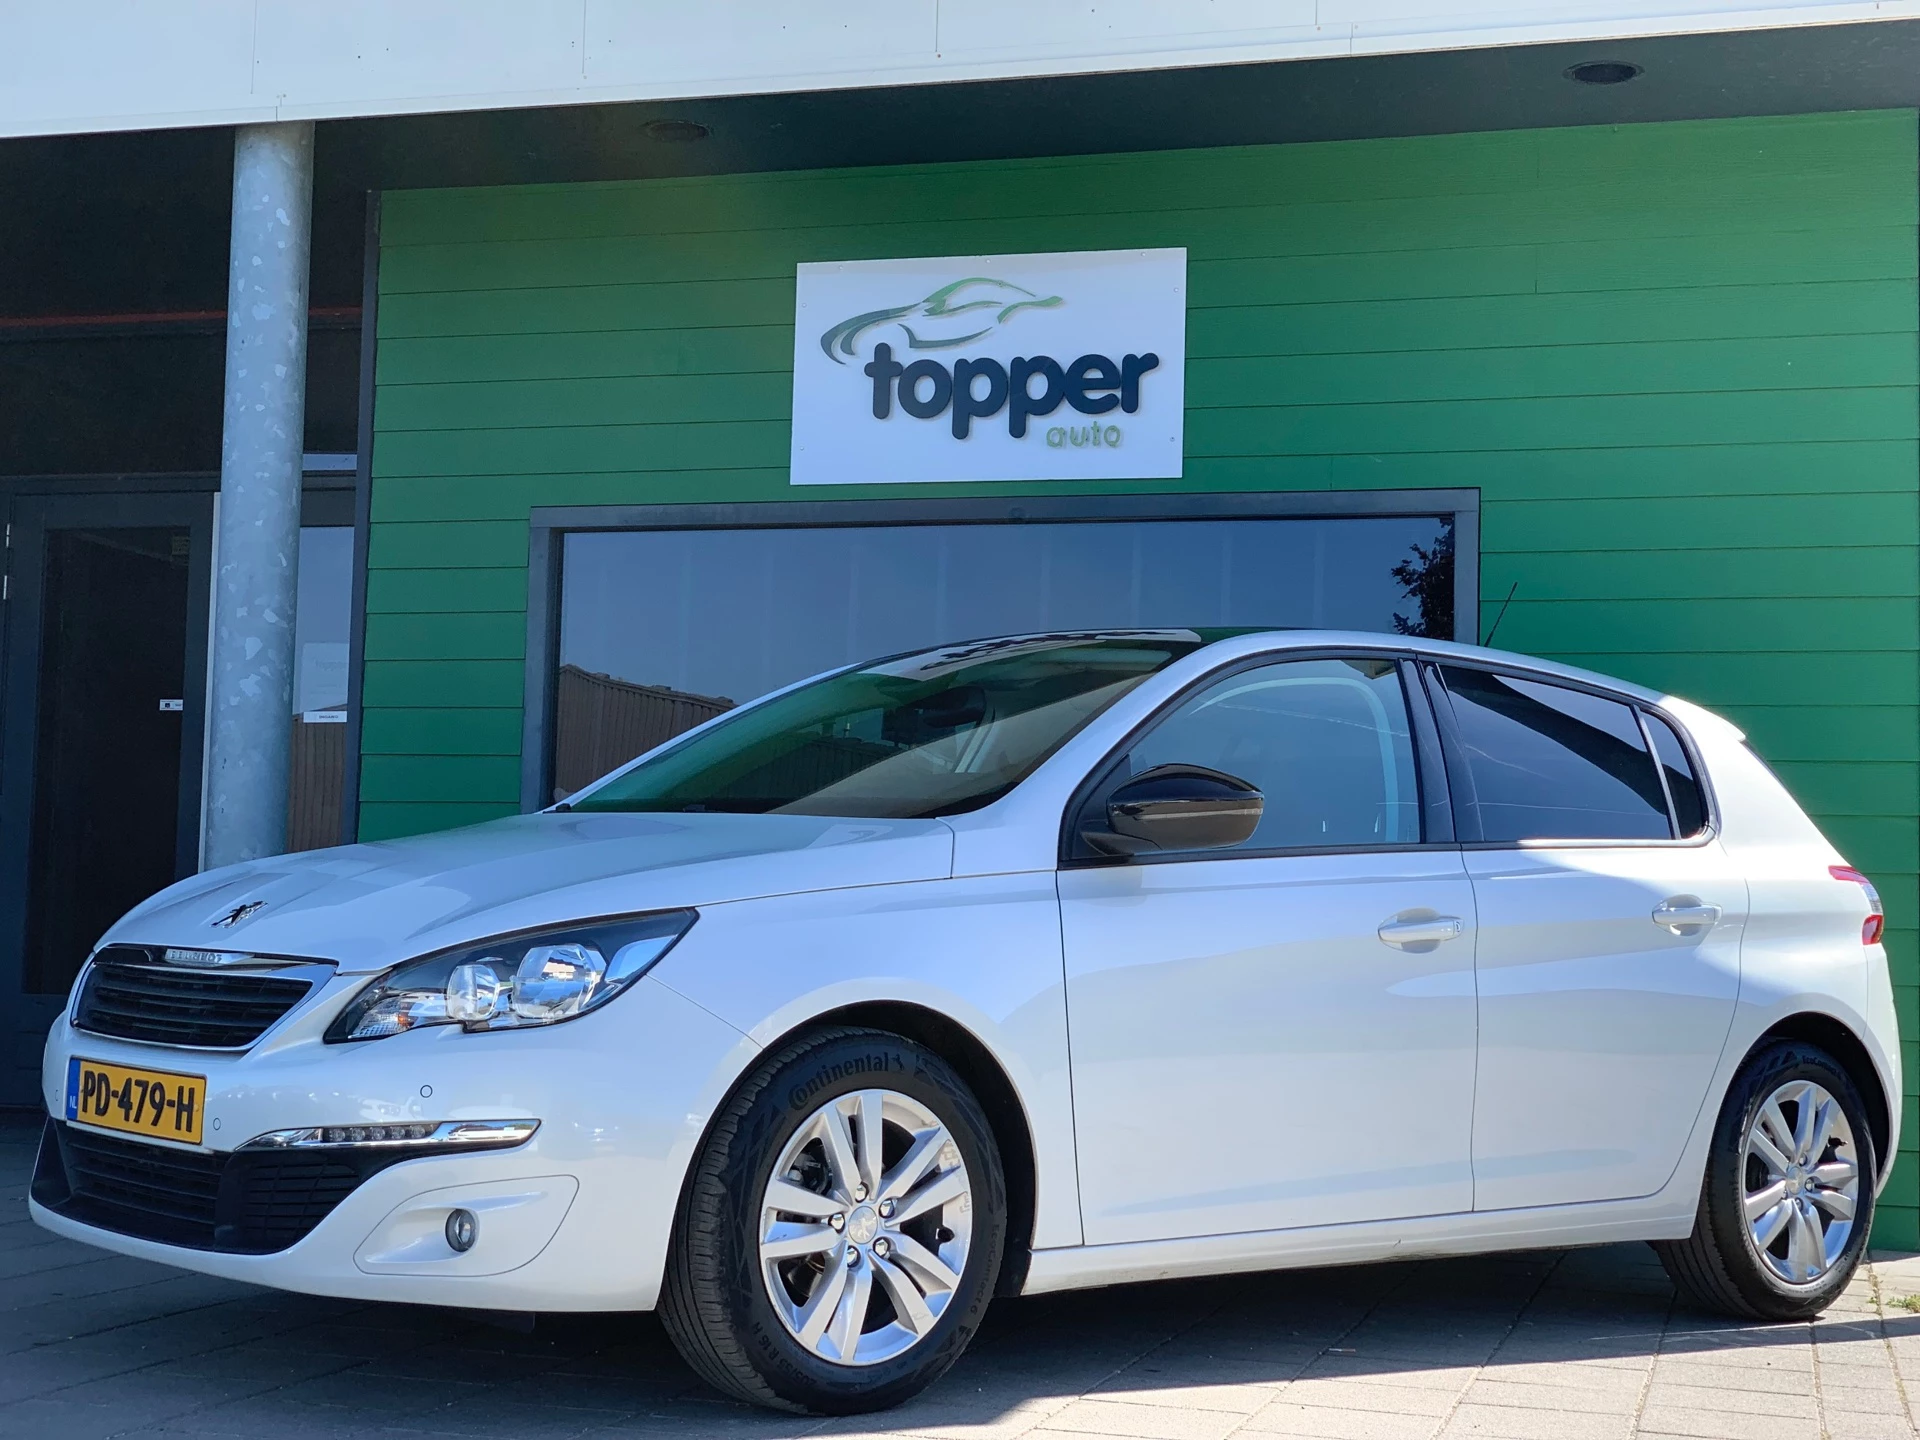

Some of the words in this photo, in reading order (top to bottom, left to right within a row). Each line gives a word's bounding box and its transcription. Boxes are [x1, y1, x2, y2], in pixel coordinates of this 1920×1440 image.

[864, 342, 1160, 440] topper
[1046, 420, 1121, 448] auto
[69, 1095, 77, 1109] NL
[82, 1070, 195, 1132] PD-479-H
[788, 1052, 889, 1110] Continental
